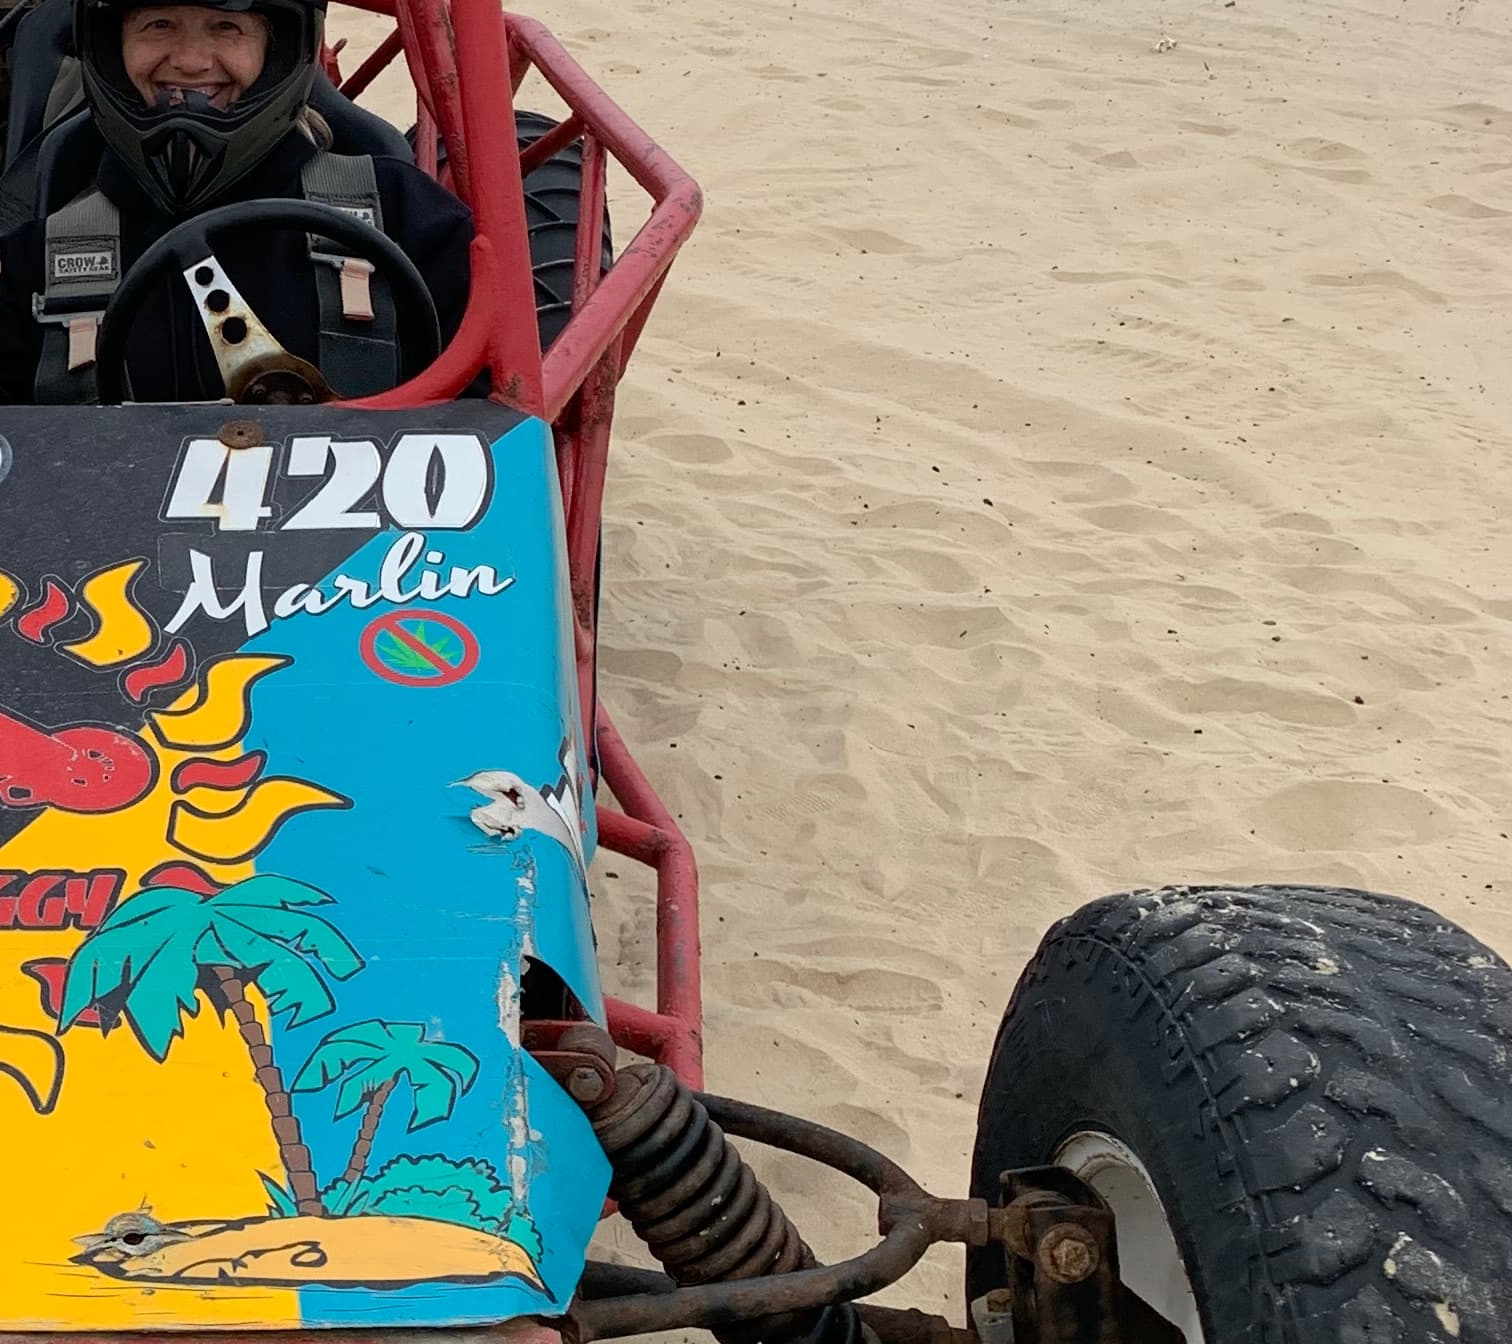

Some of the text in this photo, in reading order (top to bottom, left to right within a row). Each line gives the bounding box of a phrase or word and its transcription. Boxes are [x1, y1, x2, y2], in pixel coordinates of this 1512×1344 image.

[57, 255, 97, 270] CROW
[164, 433, 490, 531] 420
[163, 532, 515, 636] Marlin
